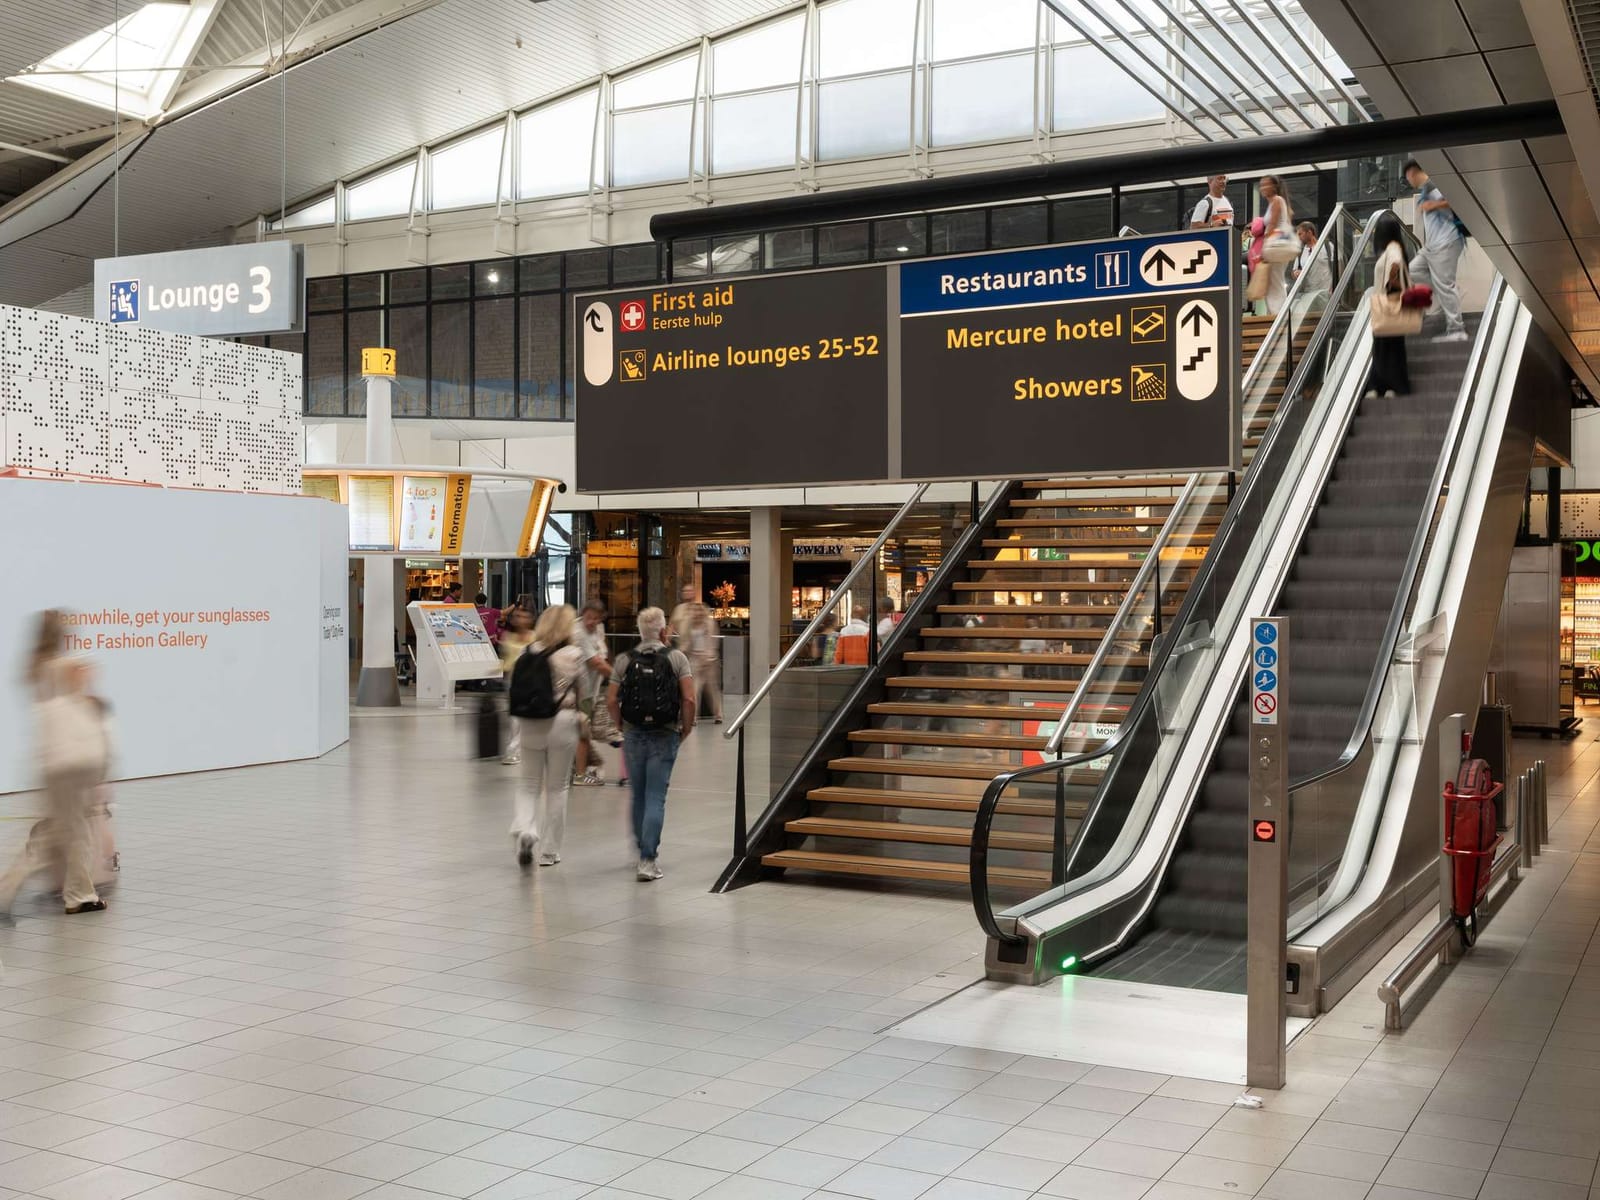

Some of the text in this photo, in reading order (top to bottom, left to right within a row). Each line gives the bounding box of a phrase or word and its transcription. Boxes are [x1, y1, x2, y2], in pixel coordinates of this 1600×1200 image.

[148, 266, 271, 313] Lounge 3
[941, 262, 1087, 295] Restaurants
[652, 285, 734, 312] First aid
[652, 312, 723, 330] Eerste hulp
[947, 314, 1122, 349] Mercure hotel
[652, 335, 879, 372] Airline lounges 25-52
[1014, 377, 1122, 400] Showers
[406, 486, 438, 497] 4 for 3
[448, 478, 465, 549] Information
[792, 545, 843, 555] JEWELRY
[135, 610, 160, 628] get
[162, 610, 195, 627] your
[197, 607, 270, 626] sunglasses
[63, 630, 208, 650] The Fashion Gallery
